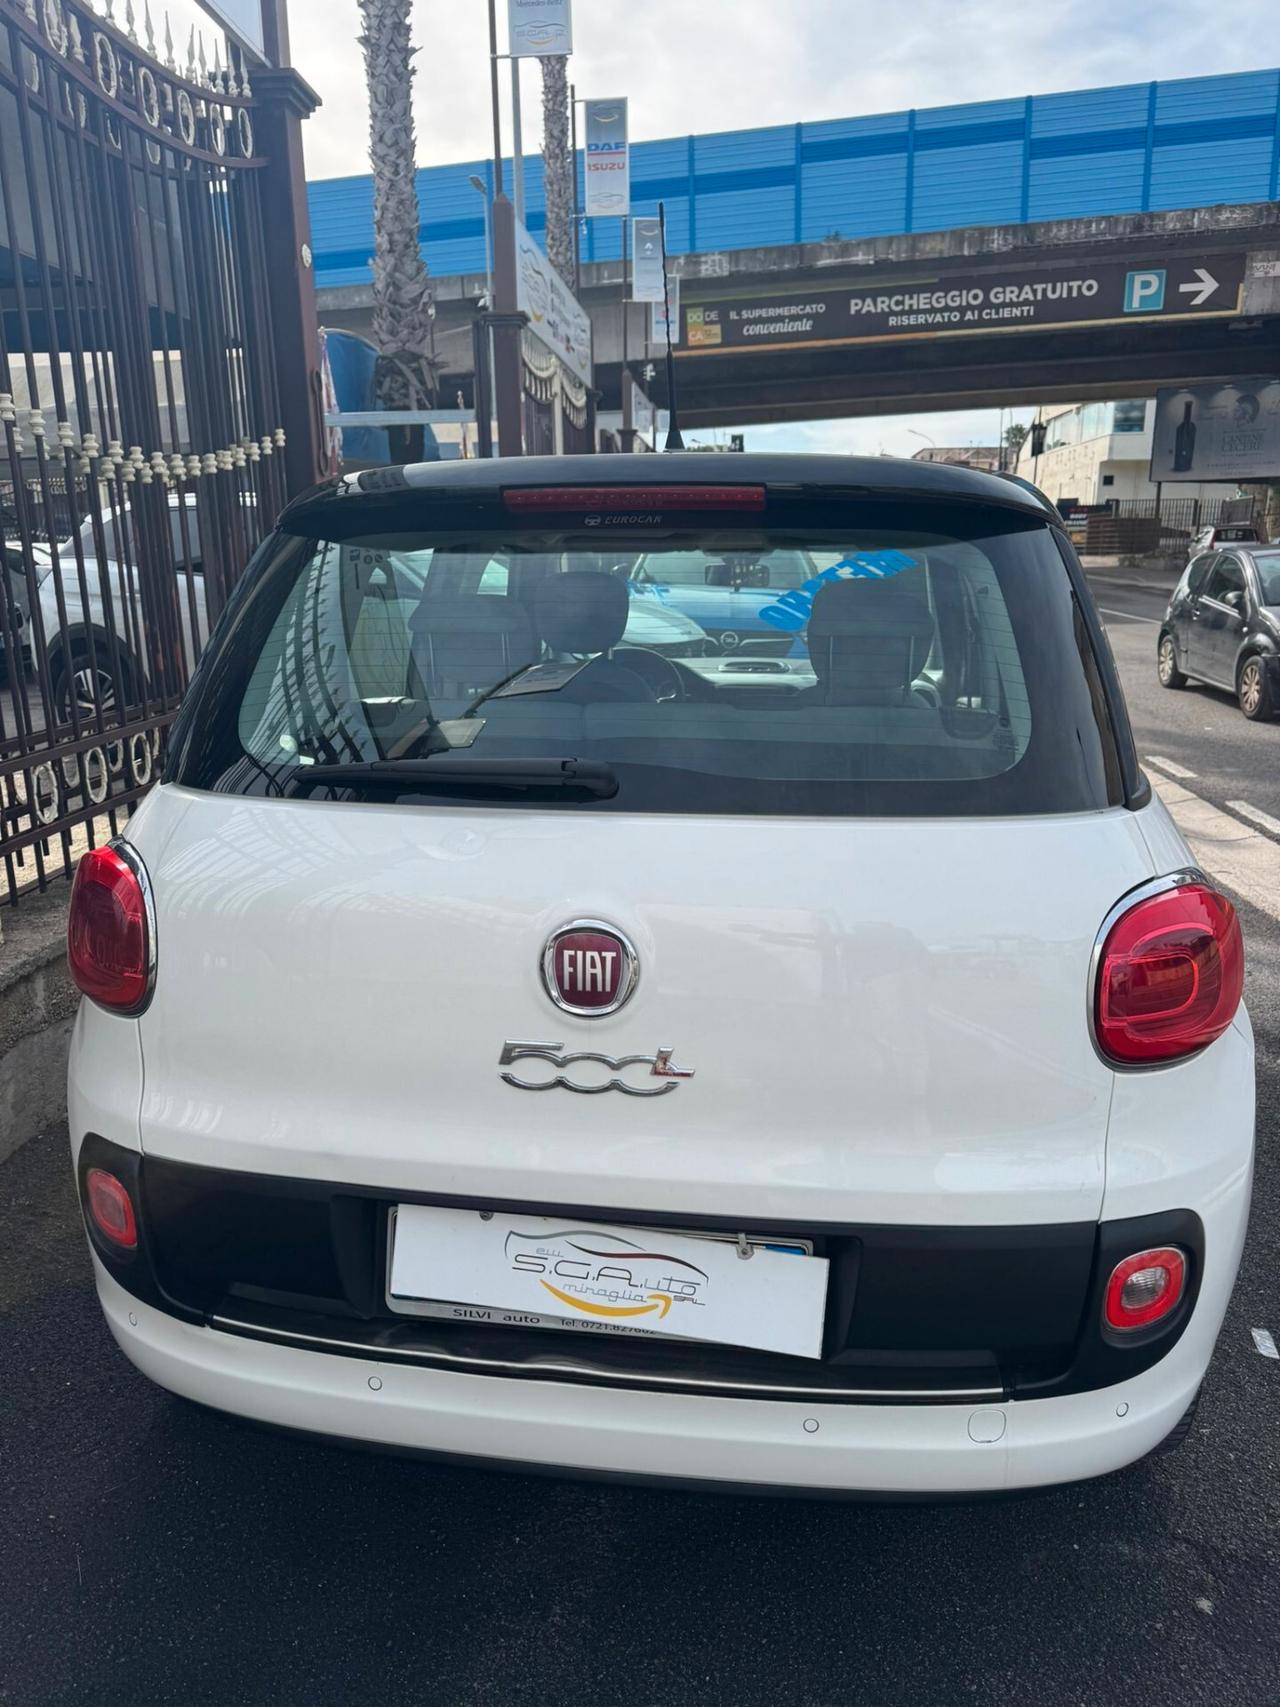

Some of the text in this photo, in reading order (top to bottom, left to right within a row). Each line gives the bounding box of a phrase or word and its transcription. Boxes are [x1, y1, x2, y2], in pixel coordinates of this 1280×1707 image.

[587, 142, 626, 152] DAF
[587, 162, 626, 172] ISUZU
[849, 278, 1099, 316] PARCHEGGIO GRATUITO
[1131, 273, 1159, 309] P
[729, 303, 826, 321] IL SUPERMERCATO
[888, 306, 1035, 327] RISERVATO AI CLIENTI
[742, 317, 814, 337] conveniente
[604, 514, 664, 525] EUROCAR
[562, 949, 617, 993] FIAT
[498, 1039, 696, 1098] 500L
[453, 1308, 492, 1320] SILVI
[503, 1315, 540, 1324] auto
